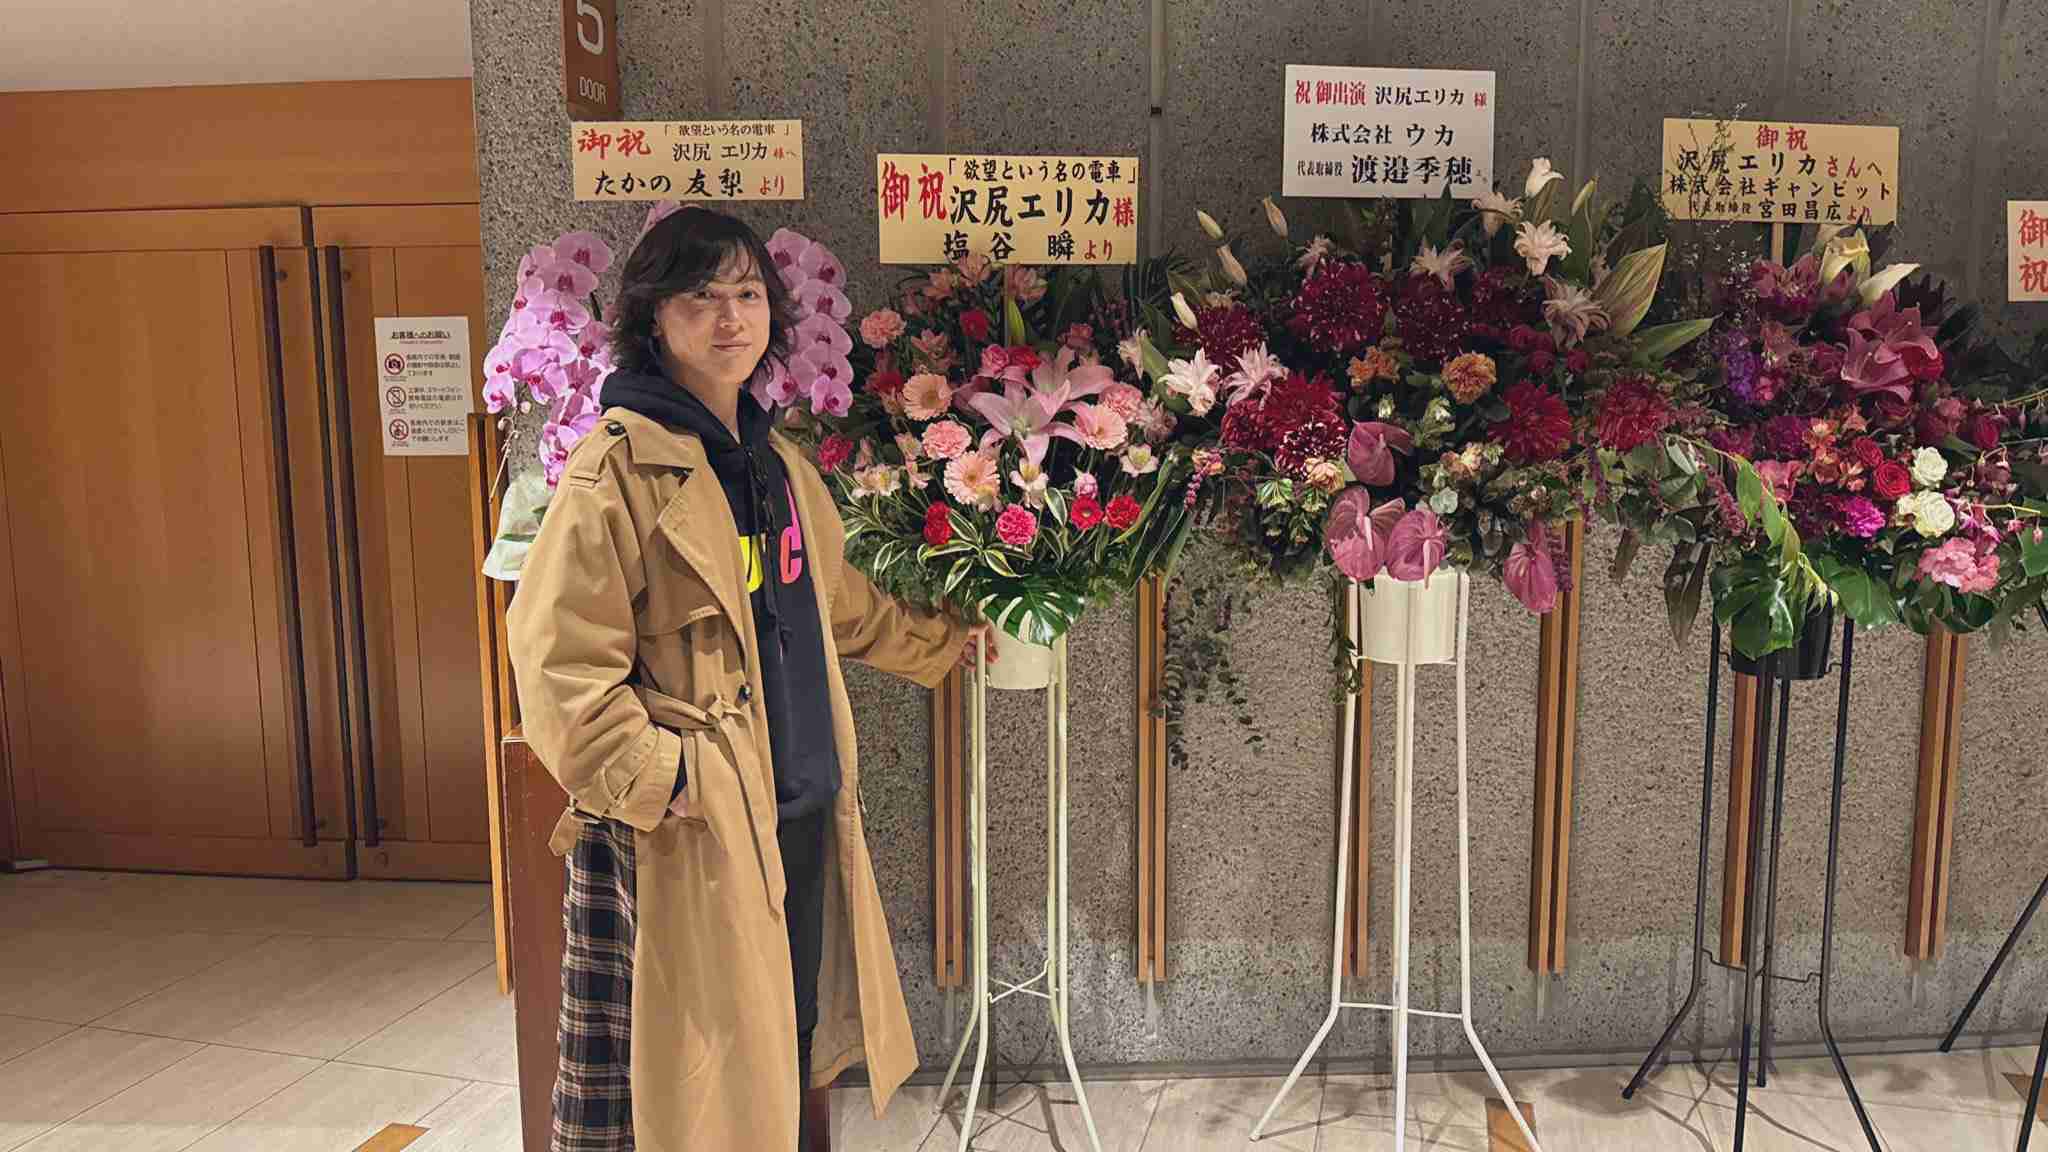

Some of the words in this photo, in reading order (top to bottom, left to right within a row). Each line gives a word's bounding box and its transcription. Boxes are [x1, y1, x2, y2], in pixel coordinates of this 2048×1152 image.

[577, 0, 605, 56] 5
[579, 76, 607, 105] DOOR
[1295, 79, 1366, 106] 祝御出演
[1375, 86, 1464, 106] 沢尻エリカ
[1473, 92, 1488, 107] 様
[577, 128, 652, 161] 御祝
[1311, 123, 1393, 145] 株式会社
[1406, 123, 1454, 146] ウカ
[1756, 124, 1808, 150] 御祝
[672, 143, 711, 162] 沢尻
[721, 142, 768, 162] エリカ
[1297, 160, 1343, 176] 代表取締役
[594, 169, 671, 196] たかの
[684, 168, 744, 197] 友梨
[759, 175, 785, 196] より
[880, 161, 948, 222] 御祝
[1758, 199, 1842, 222] 宮田昌広
[1083, 239, 1114, 260] より
